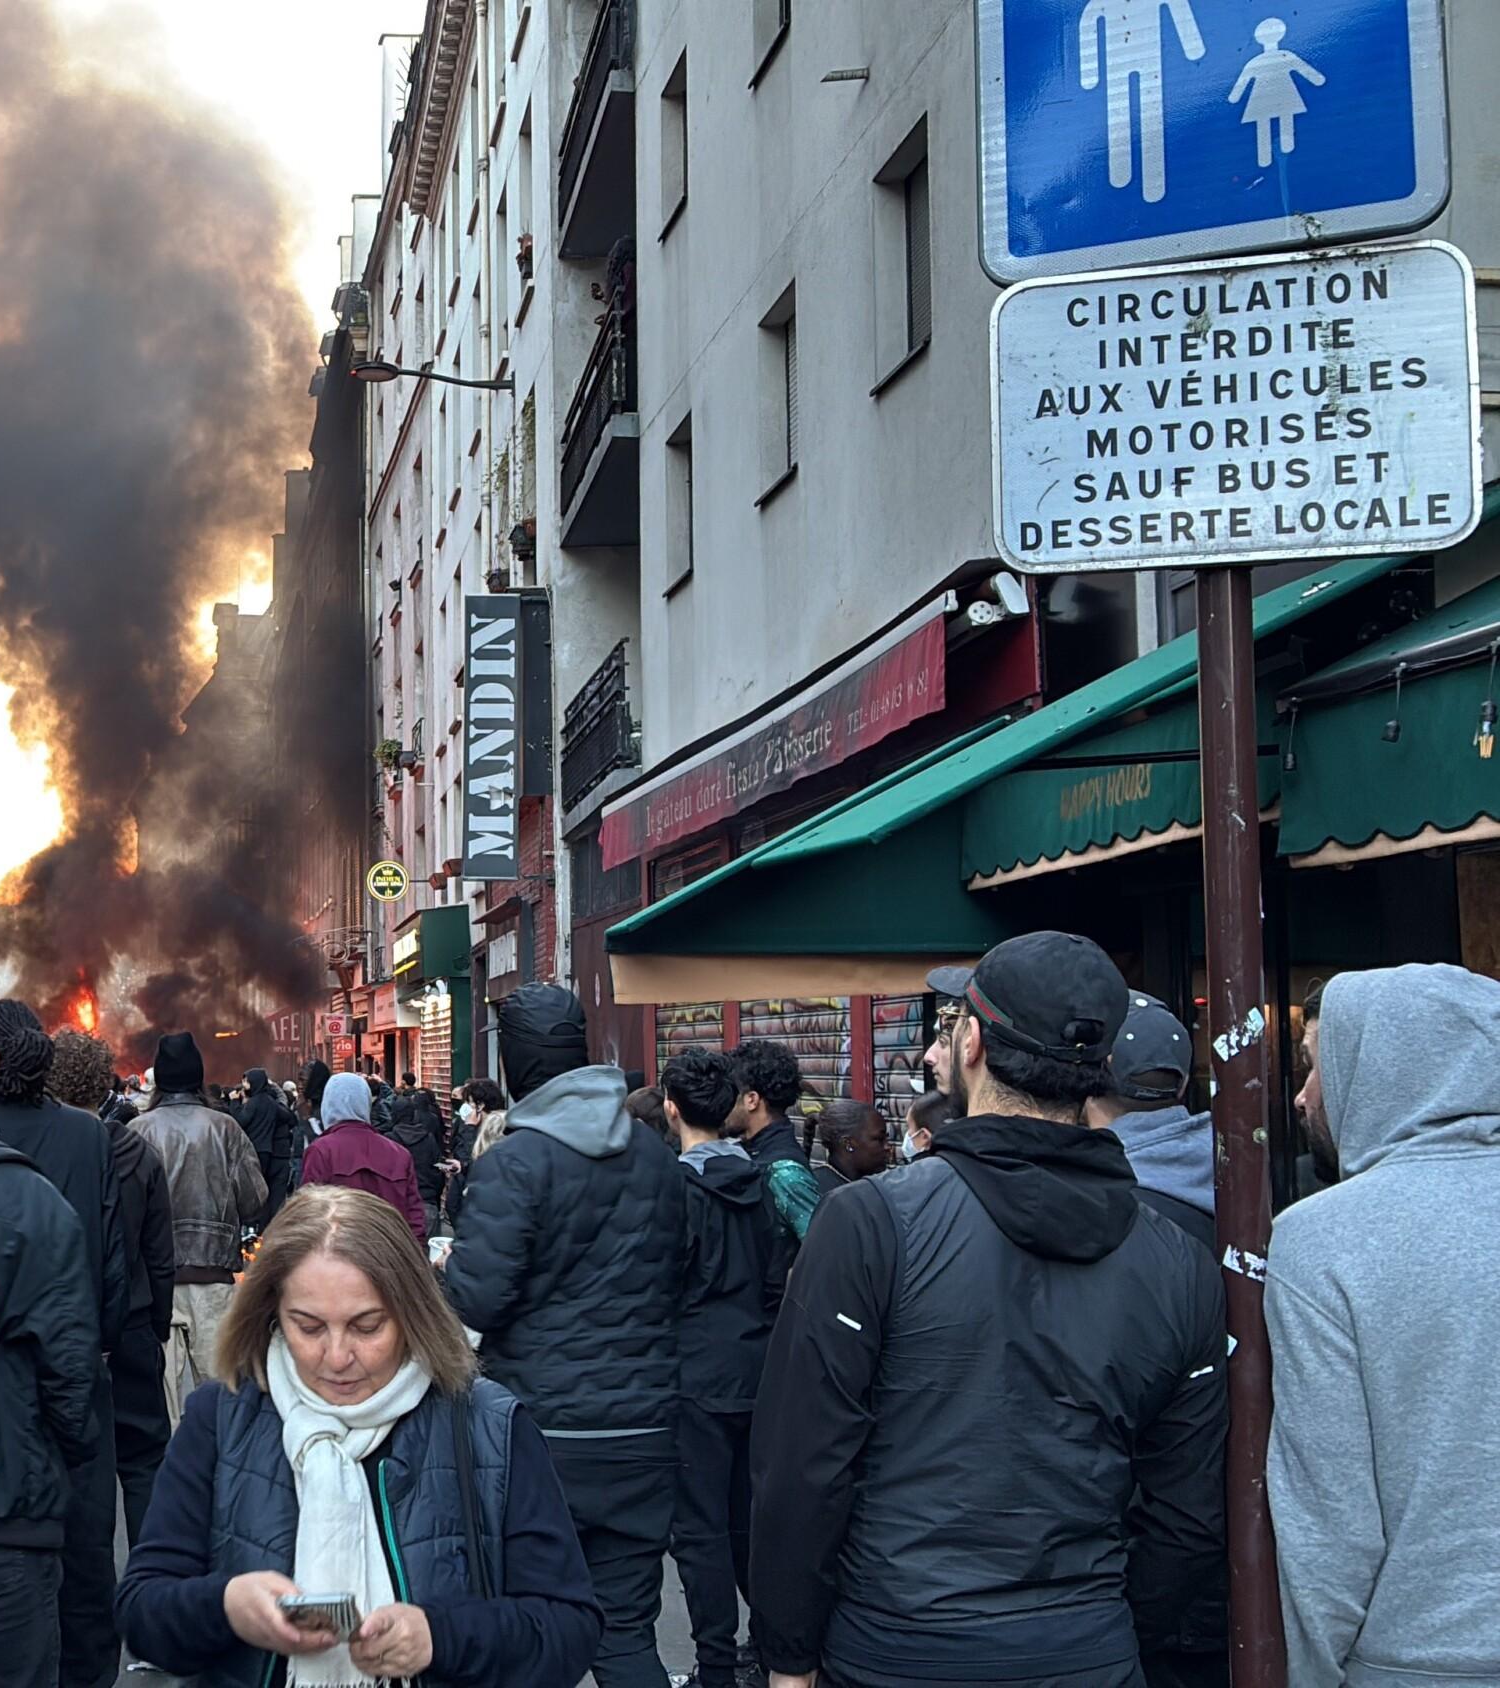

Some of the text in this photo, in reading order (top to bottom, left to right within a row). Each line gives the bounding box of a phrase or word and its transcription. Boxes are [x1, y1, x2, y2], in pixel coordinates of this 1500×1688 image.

[1067, 269, 1389, 327] CIRCULATION
[1099, 318, 1355, 369] INTERDITE
[1035, 357, 1428, 419] AUX VÉHICULES
[1086, 404, 1373, 458] MOTORISÉS
[1073, 451, 1390, 503] SAUF BUS ET
[1020, 493, 1452, 552] DESSERTE LOCALE
[468, 613, 516, 860] MANDIN
[1106, 763, 1152, 807] HOURS
